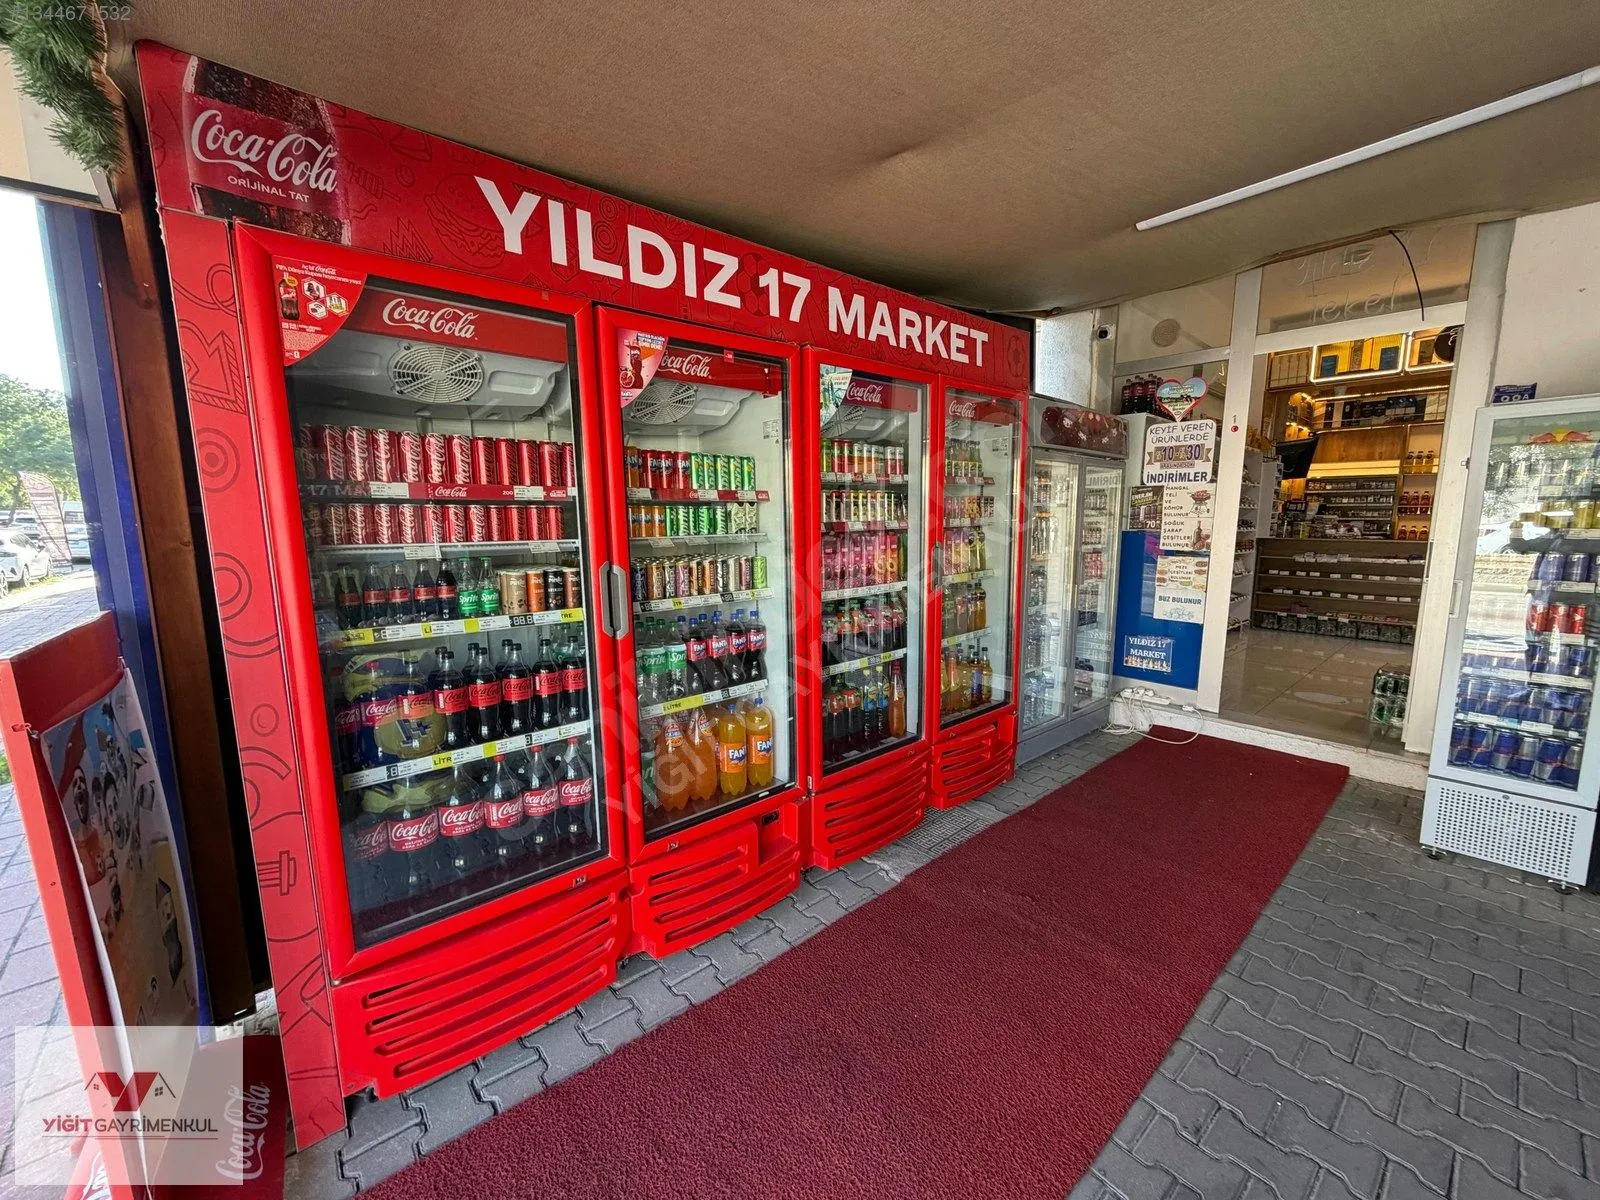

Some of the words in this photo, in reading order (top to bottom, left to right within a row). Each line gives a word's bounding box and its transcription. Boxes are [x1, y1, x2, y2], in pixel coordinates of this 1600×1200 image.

[191, 109, 338, 194] Coca-Cola
[290, 189, 310, 203] TAT
[474, 176, 741, 308] YILDIZ
[759, 268, 810, 323] 17
[828, 287, 988, 367] MARKET
[383, 298, 478, 340] Coca-Cola
[660, 350, 713, 378] oca-Cola
[846, 382, 883, 404] Coca-Cola
[949, 400, 976, 418] Coca-Cola
[1150, 425, 1177, 435] KEYİF
[1181, 422, 1214, 432] VEREN
[1151, 433, 1210, 445] ÜRÜNLERDE
[1147, 470, 1207, 483] İNDİRİMLER
[435, 486, 467, 497] Coca-Cola
[1128, 637, 1156, 647] YILDIZ
[1130, 649, 1166, 659] MARKET
